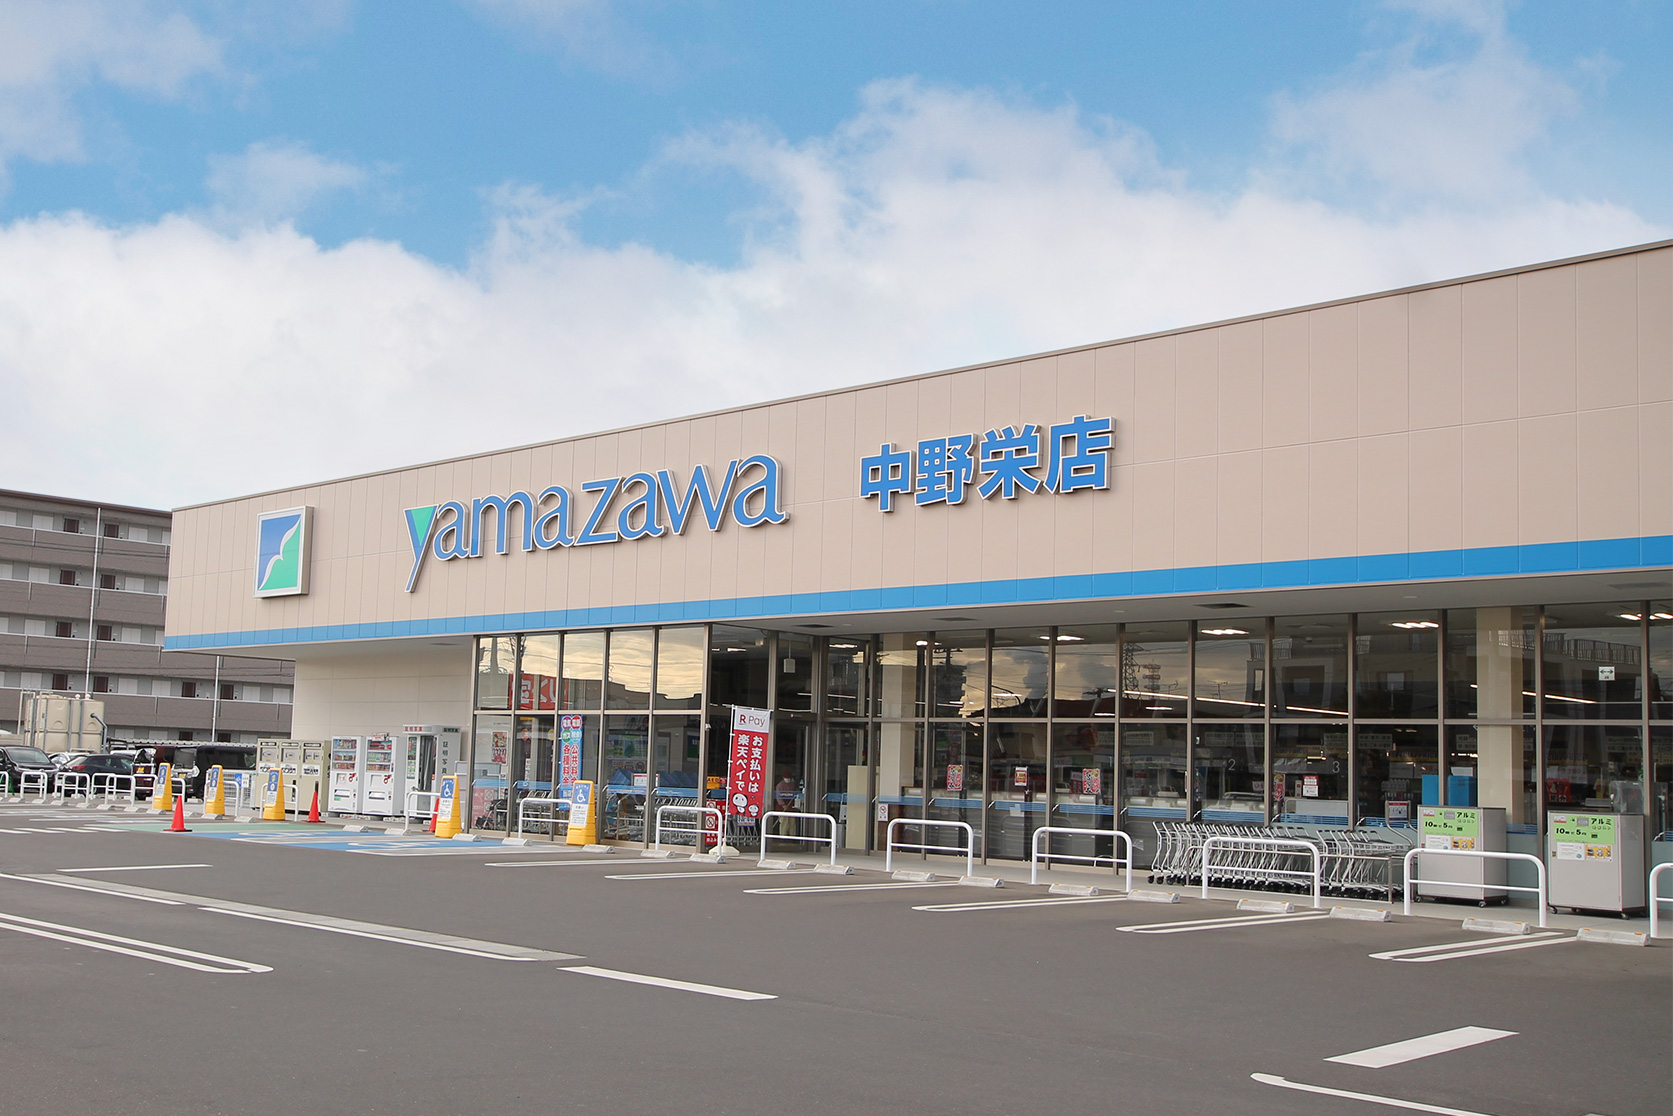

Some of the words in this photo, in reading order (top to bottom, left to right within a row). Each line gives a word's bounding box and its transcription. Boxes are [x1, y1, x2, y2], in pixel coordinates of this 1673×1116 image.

[860, 414, 1117, 513] 中野栄店
[404, 453, 790, 593] yamazawa
[739, 714, 747, 724] R
[748, 715, 766, 727] Pay
[735, 734, 750, 791] 楽天ペイで
[748, 735, 764, 793] お支払いは
[1227, 759, 1236, 771] 2
[1332, 761, 1340, 774] 3
[1456, 811, 1476, 819] アルミ
[1591, 817, 1612, 826] アルミ
